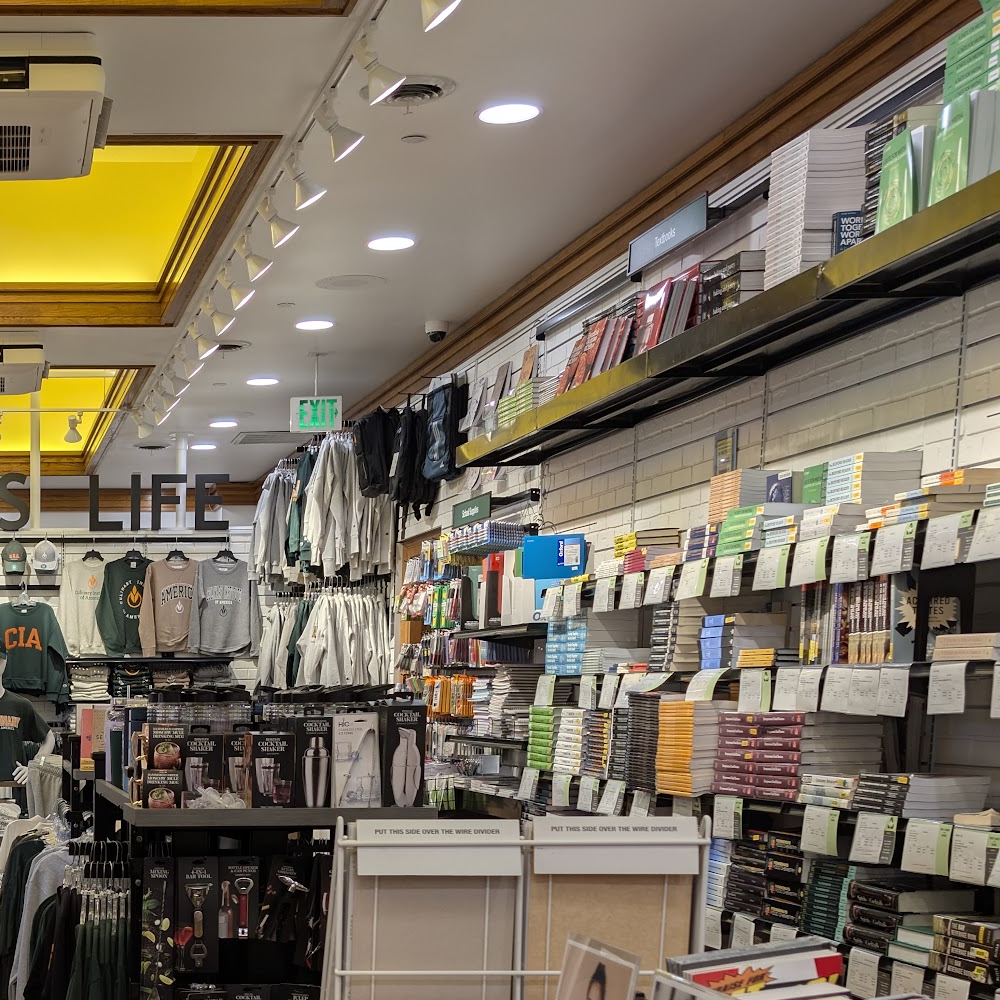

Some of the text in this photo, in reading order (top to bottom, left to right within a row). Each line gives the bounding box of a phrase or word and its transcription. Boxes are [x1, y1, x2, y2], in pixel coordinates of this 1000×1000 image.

[655, 228, 676, 248] Textbooks
[299, 399, 337, 428] EXIT
[89, 474, 230, 532] LIFE
[4, 627, 42, 651] CIA
